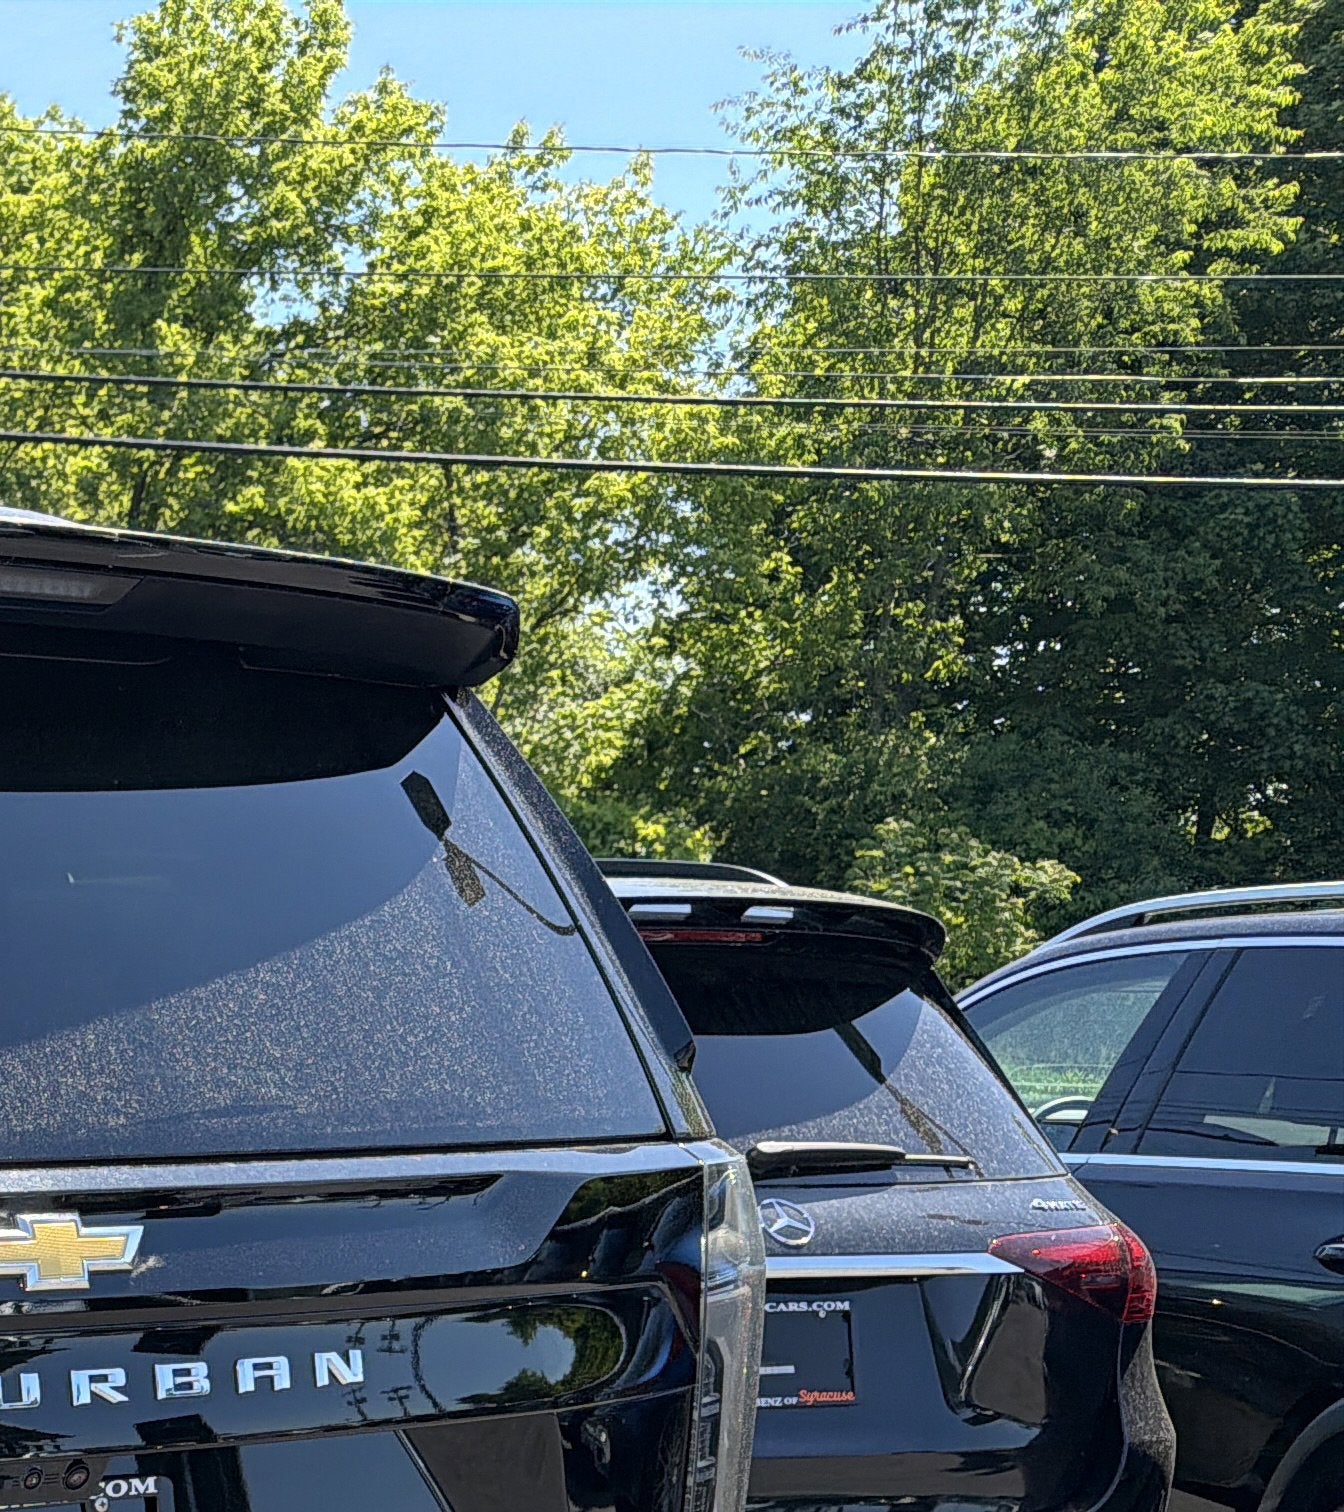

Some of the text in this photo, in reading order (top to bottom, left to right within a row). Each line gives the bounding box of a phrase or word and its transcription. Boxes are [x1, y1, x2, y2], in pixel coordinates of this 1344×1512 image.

[764, 1301, 850, 1312] CARS.COM
[784, 1396, 799, 1405] OF
[799, 1390, 855, 1405] Syracuse
